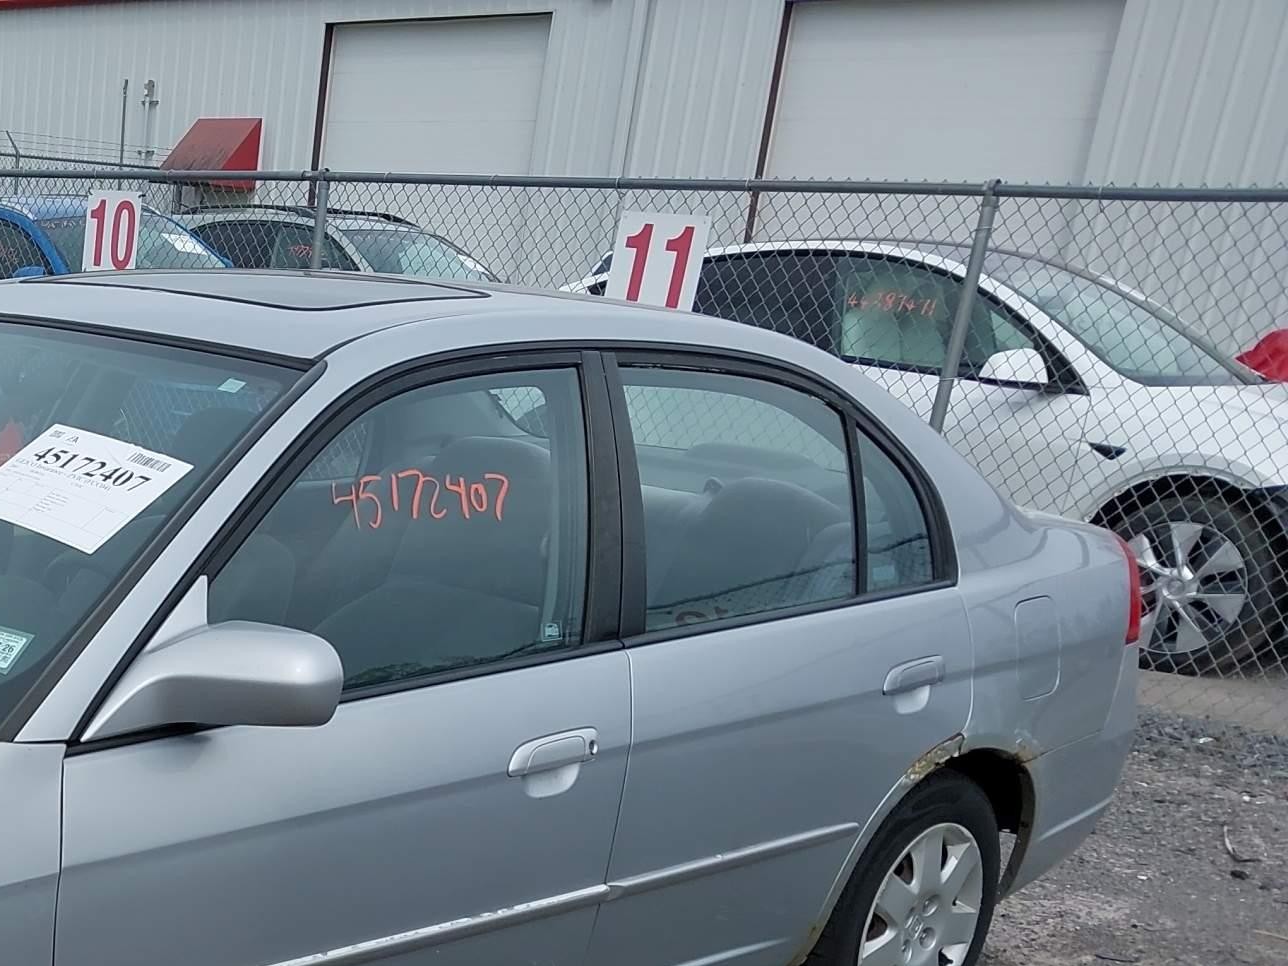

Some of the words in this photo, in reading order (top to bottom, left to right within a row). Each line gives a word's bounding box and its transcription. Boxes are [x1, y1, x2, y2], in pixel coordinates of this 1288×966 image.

[91, 199, 136, 271] 10
[625, 223, 695, 309] 11
[34, 446, 152, 492] 45172407
[331, 468, 509, 530] 45172407
